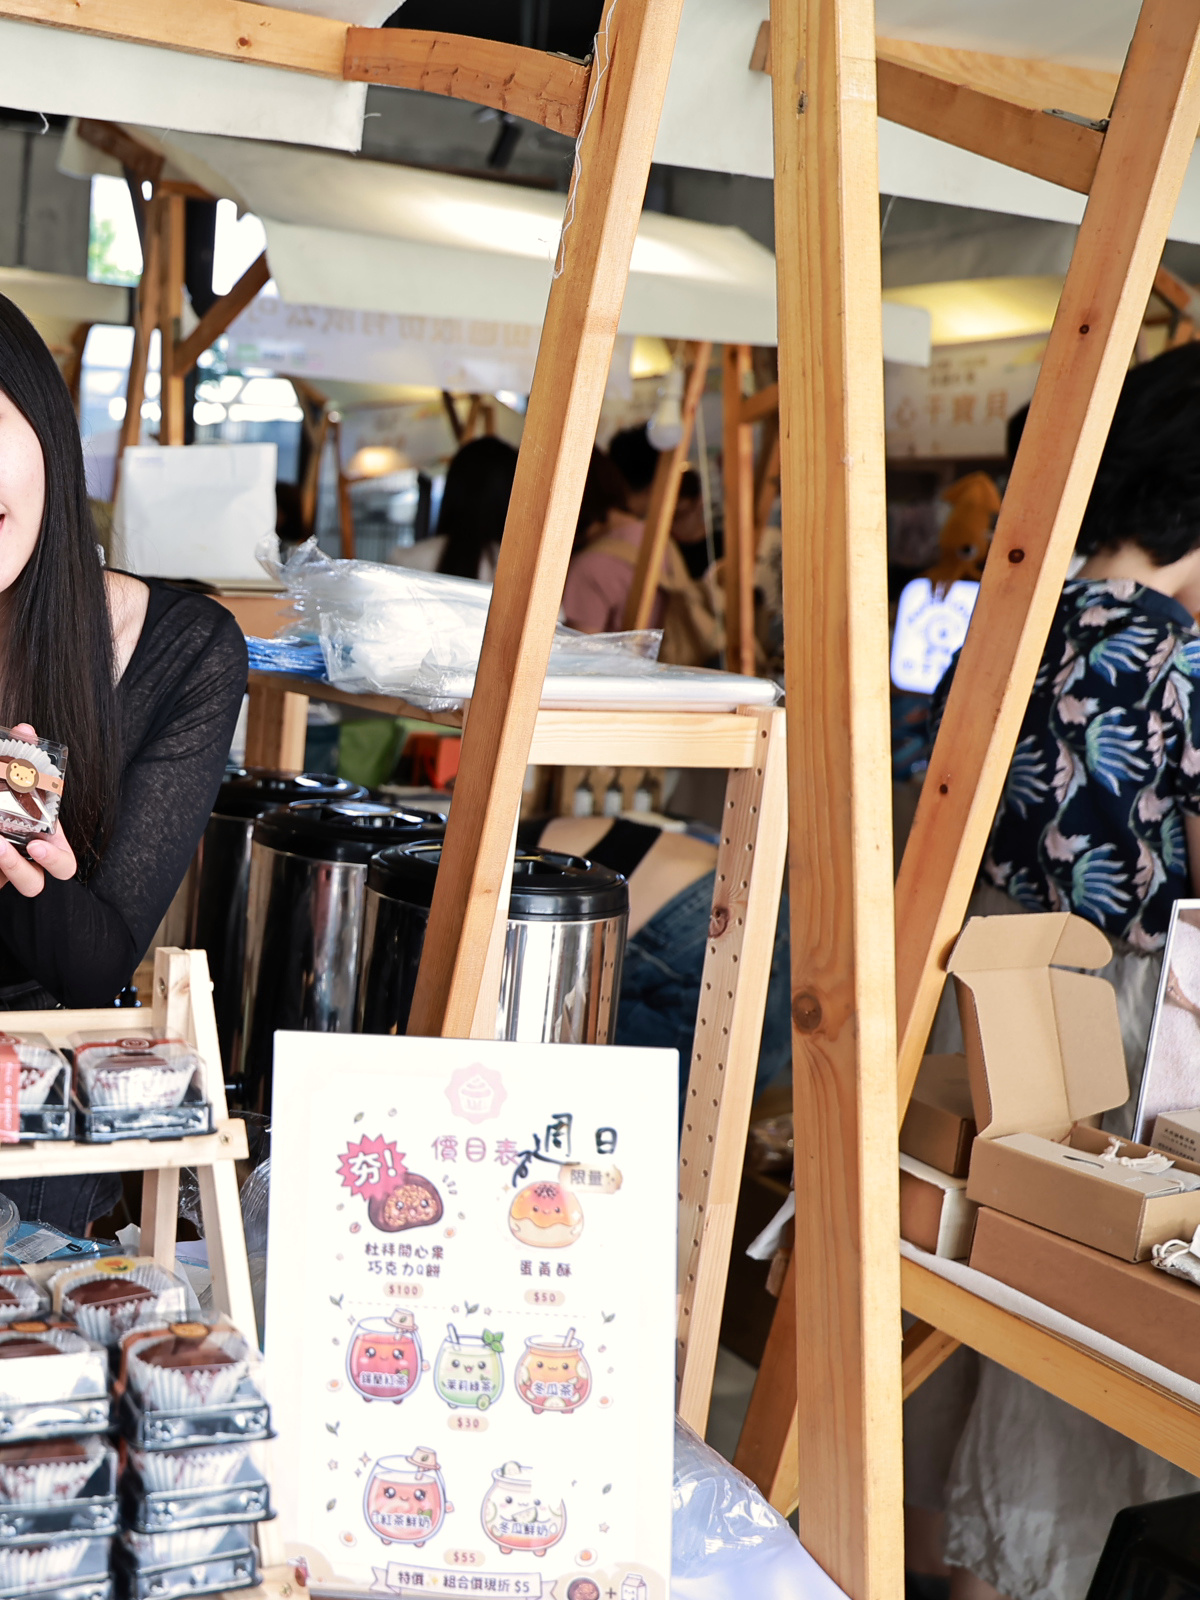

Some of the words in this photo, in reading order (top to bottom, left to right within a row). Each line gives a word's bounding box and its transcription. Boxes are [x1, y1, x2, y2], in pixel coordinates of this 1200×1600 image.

[431, 1135, 519, 1166] 價目表
[570, 1168, 603, 1186] 限量
[364, 1242, 444, 1260] 杜拜開心果
[367, 1260, 441, 1278] 巧克力Q餅
[519, 1260, 573, 1278] 蛋黃酥
[388, 1284, 419, 1296] $100
[534, 1291, 557, 1303] $50
[534, 1382, 572, 1396] 冬瓜茶
[457, 1417, 480, 1428] $30
[499, 1522, 550, 1537] 冬瓜鮮奶
[453, 1551, 476, 1563] $55
[398, 1571, 425, 1586] 特價
[514, 1581, 530, 1593] $5
